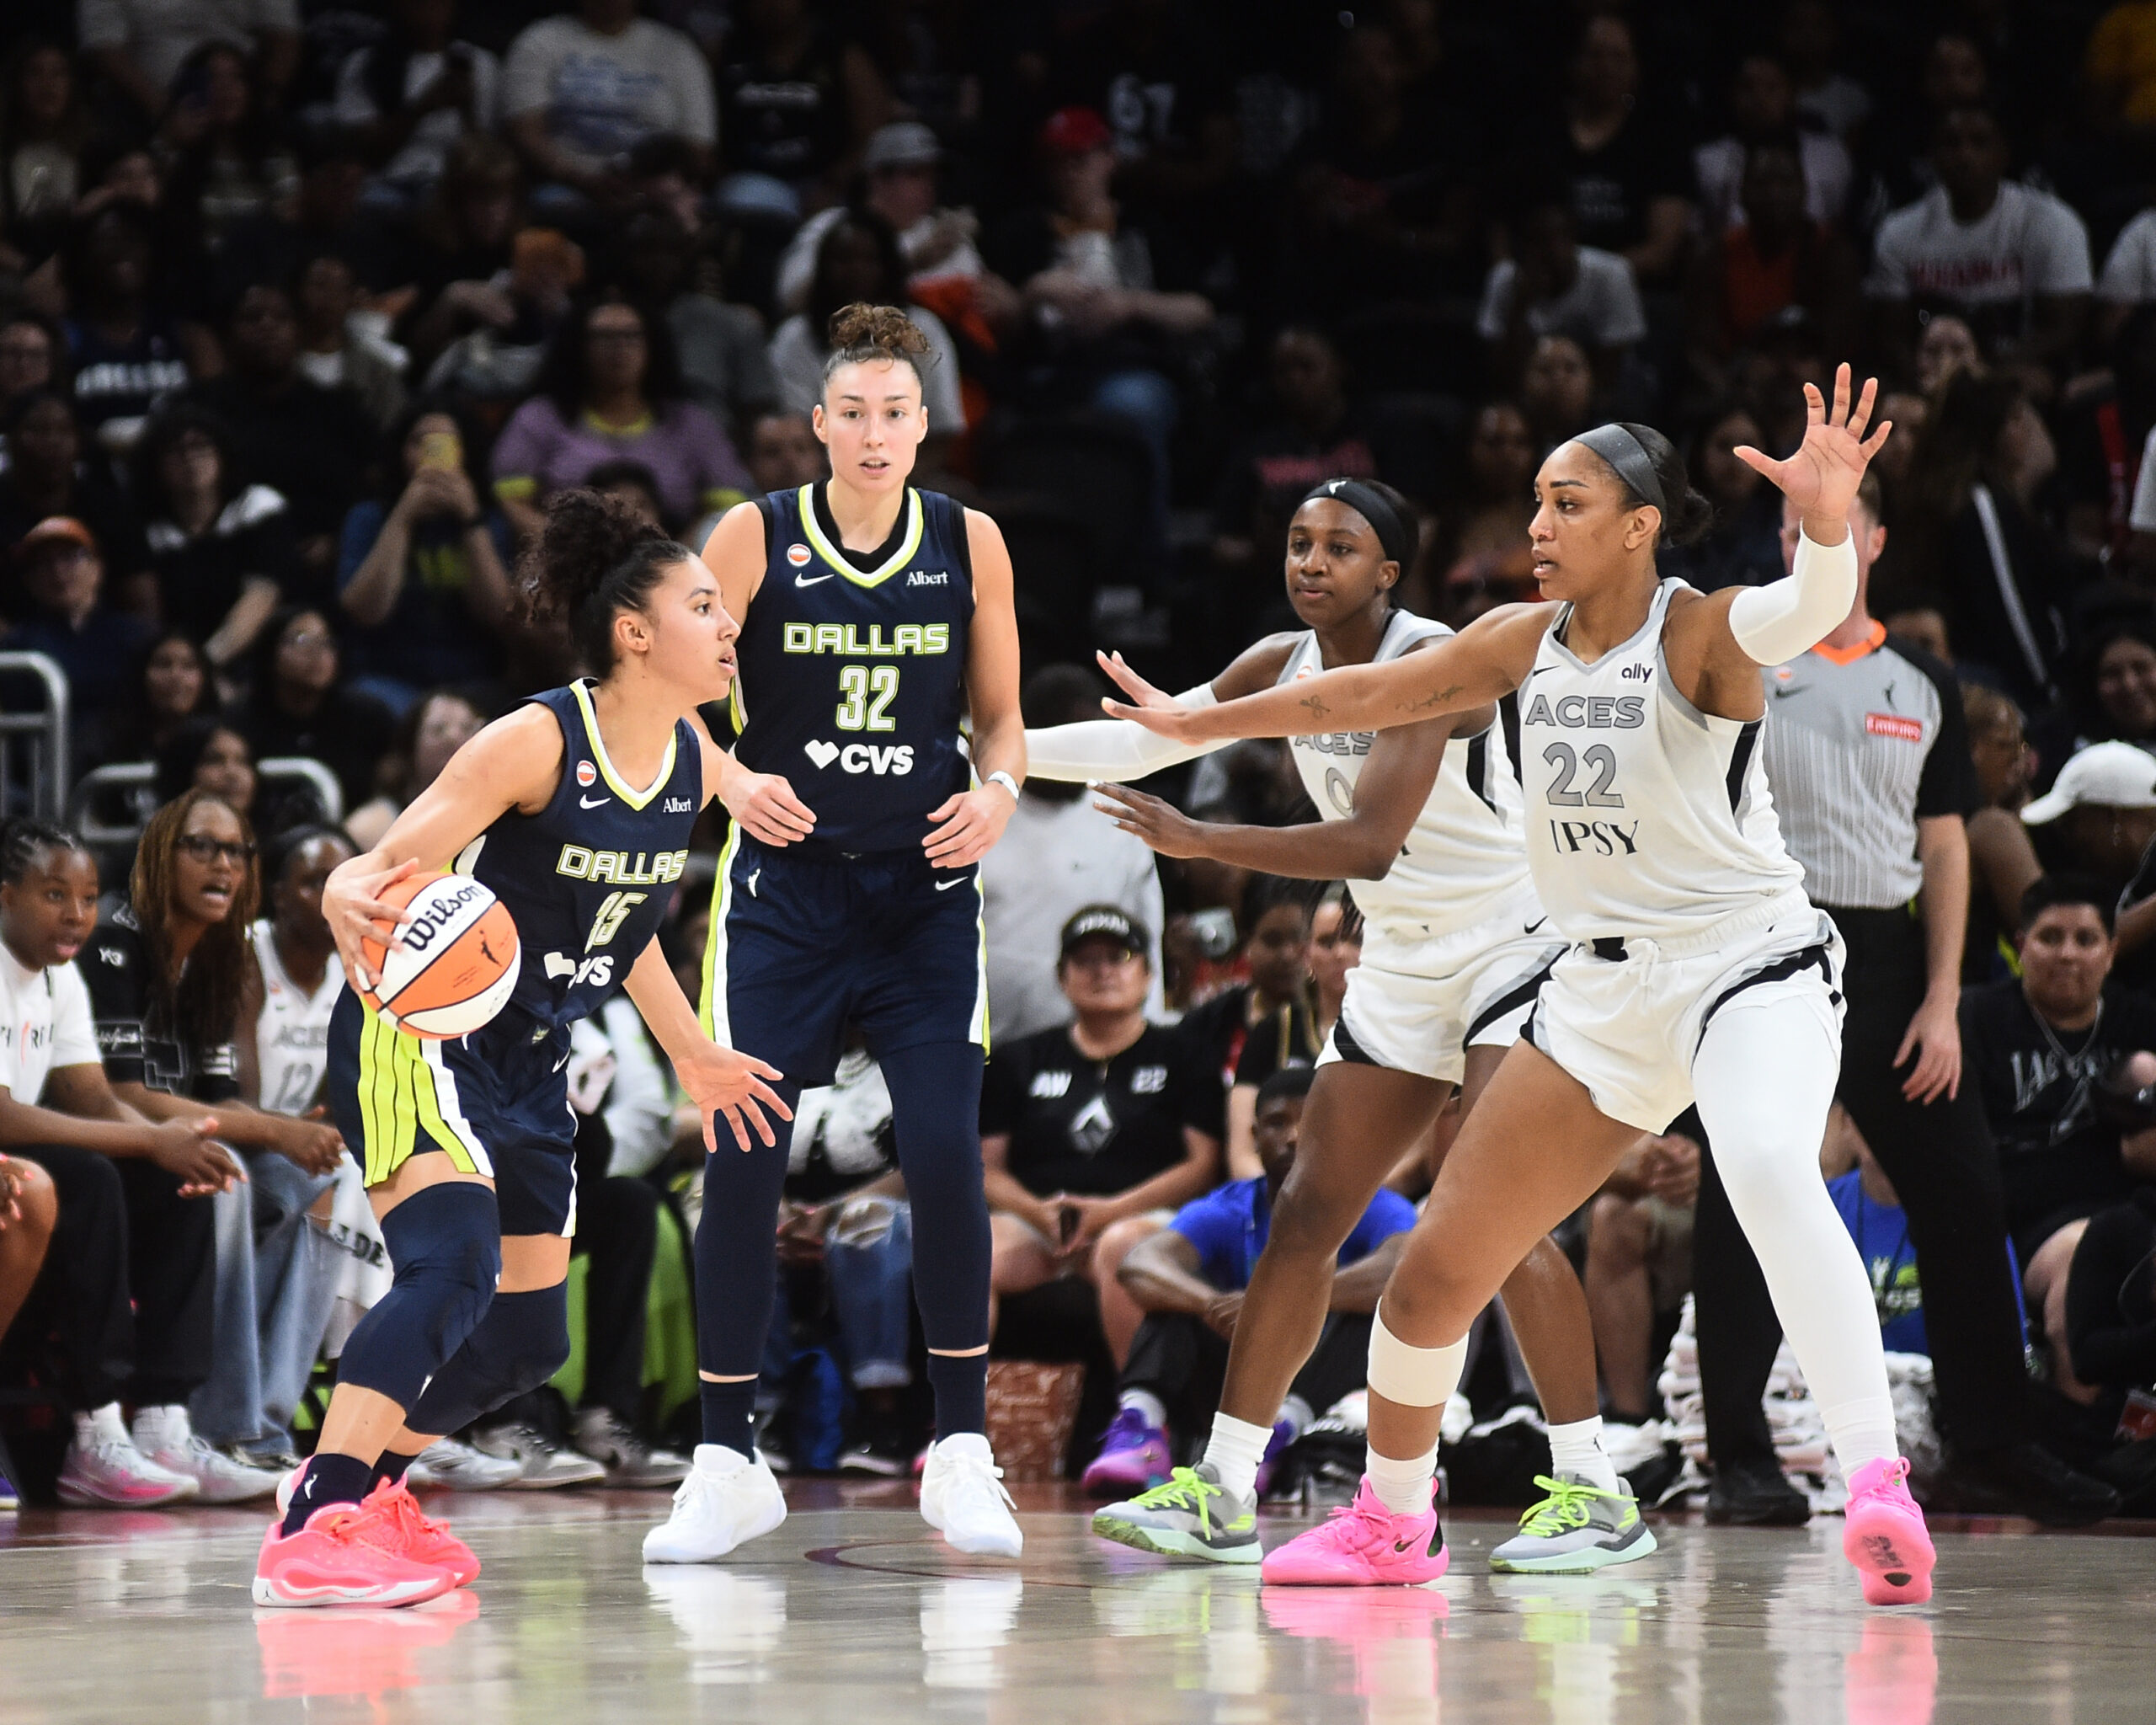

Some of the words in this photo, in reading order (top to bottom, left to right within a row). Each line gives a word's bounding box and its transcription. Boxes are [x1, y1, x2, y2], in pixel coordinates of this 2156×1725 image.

[906, 571, 948, 586] Albert
[783, 622, 949, 654] DALLAS
[1621, 663, 1653, 683] ally
[835, 665, 899, 731] 32
[1525, 694, 1646, 729] ACES
[841, 744, 915, 775] CVS
[1542, 742, 1625, 808] 22
[663, 798, 692, 813] Albert
[1326, 767, 1354, 818] 0
[555, 844, 689, 884] DALLAS
[402, 885, 485, 952] Wilson
[272, 1063, 312, 1109] 12
